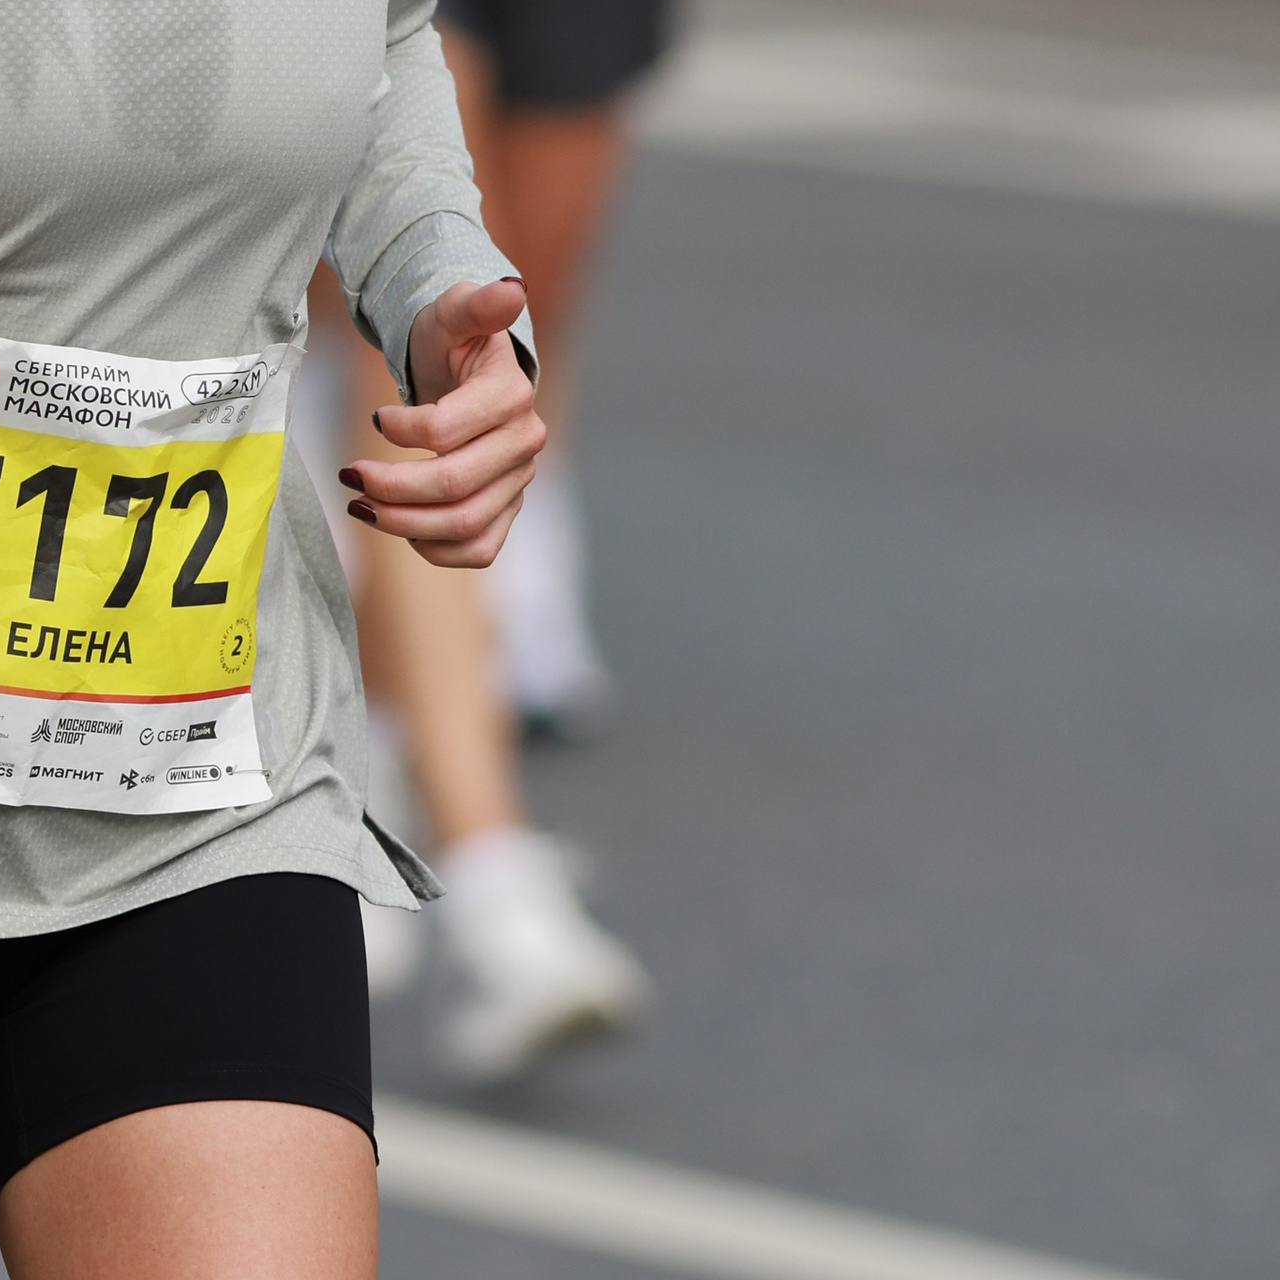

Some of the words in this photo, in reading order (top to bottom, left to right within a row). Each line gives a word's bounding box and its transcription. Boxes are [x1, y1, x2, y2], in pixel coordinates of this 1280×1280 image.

[15, 360, 130, 383] СБЕРПРАЙМ
[9, 376, 172, 410] МОСКОВСКИЙ
[4, 396, 132, 429] МАРАФОН
[191, 405, 250, 424] 2026
[6, 621, 133, 665] ЕЛЕНА
[231, 634, 244, 657] 2
[57, 718, 124, 736] МОСКОВСКИЙ
[157, 728, 187, 743] СБЕР
[54, 731, 87, 746] СПОРТ
[169, 769, 208, 781] WINLINE
